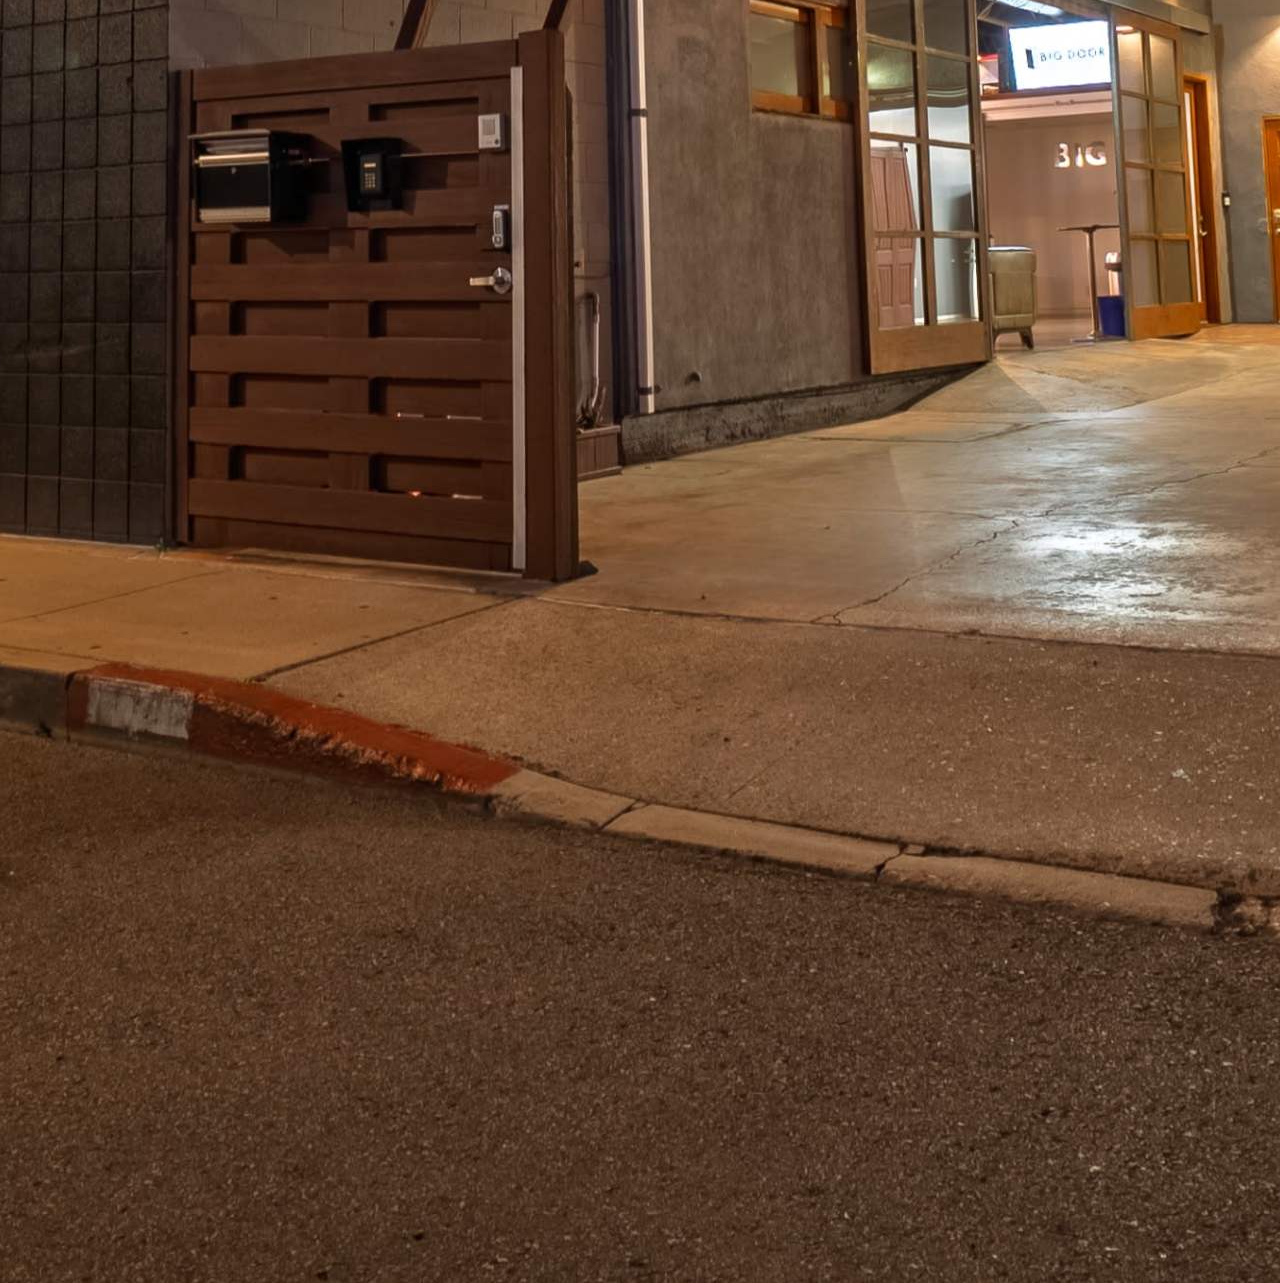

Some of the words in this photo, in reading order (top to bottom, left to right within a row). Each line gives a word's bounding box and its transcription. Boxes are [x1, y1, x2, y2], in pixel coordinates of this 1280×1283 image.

[1039, 51, 1063, 62] BIG
[1067, 45, 1105, 60] DOOR
[1055, 142, 1107, 168] BIG
